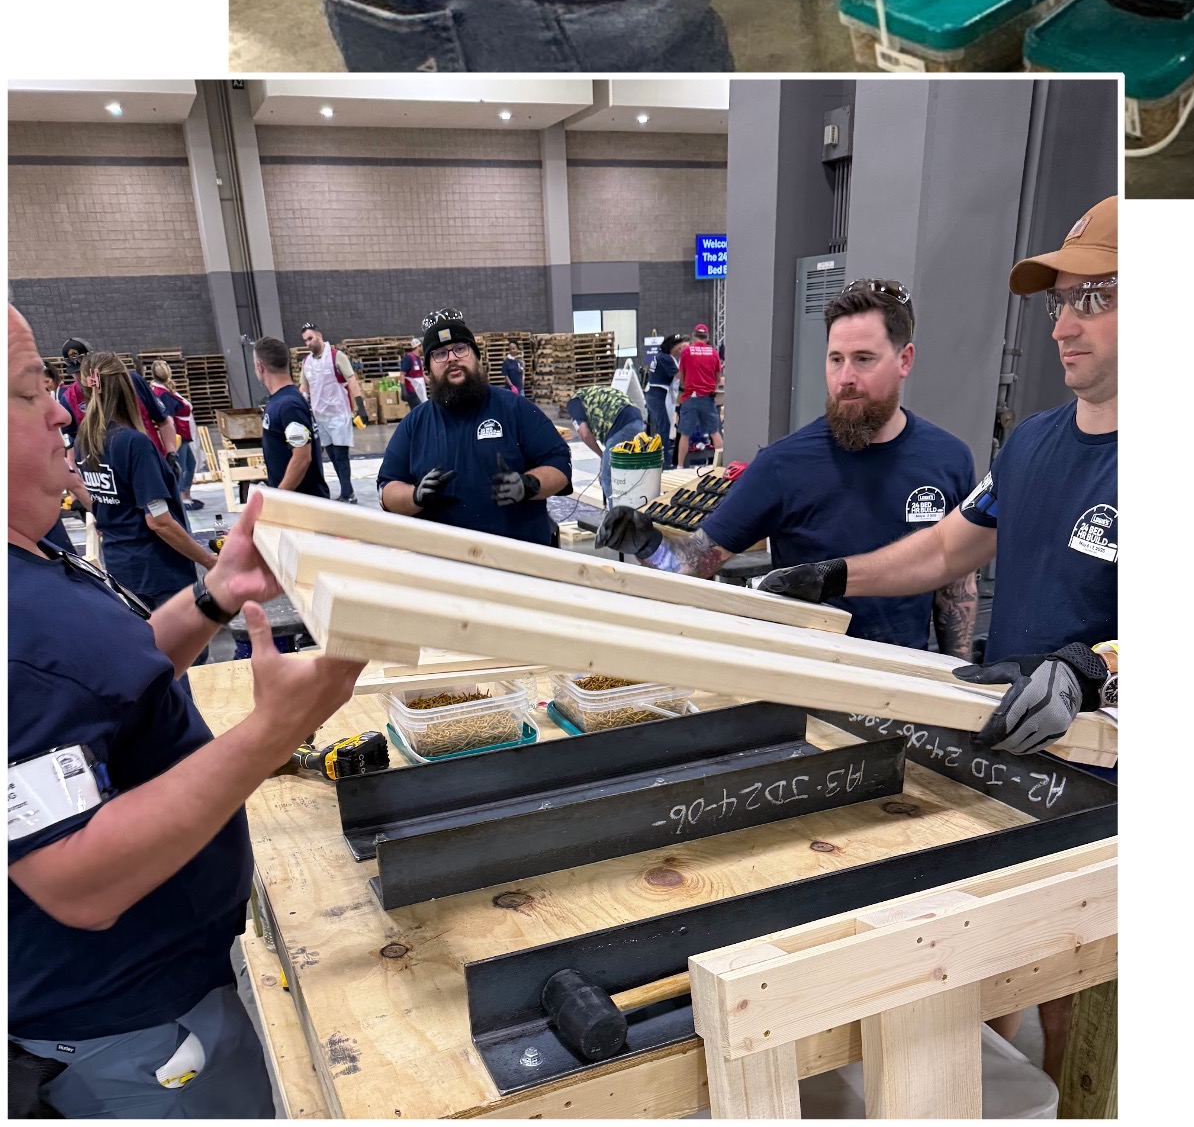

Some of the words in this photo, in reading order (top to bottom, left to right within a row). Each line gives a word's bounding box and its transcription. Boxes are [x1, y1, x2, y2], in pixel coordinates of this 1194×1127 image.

[702, 239, 727, 249] Welco
[702, 253, 717, 262] The
[708, 265, 722, 274] Bed
[1089, 525, 1104, 536] BED
[1086, 533, 1108, 546] BUILD
